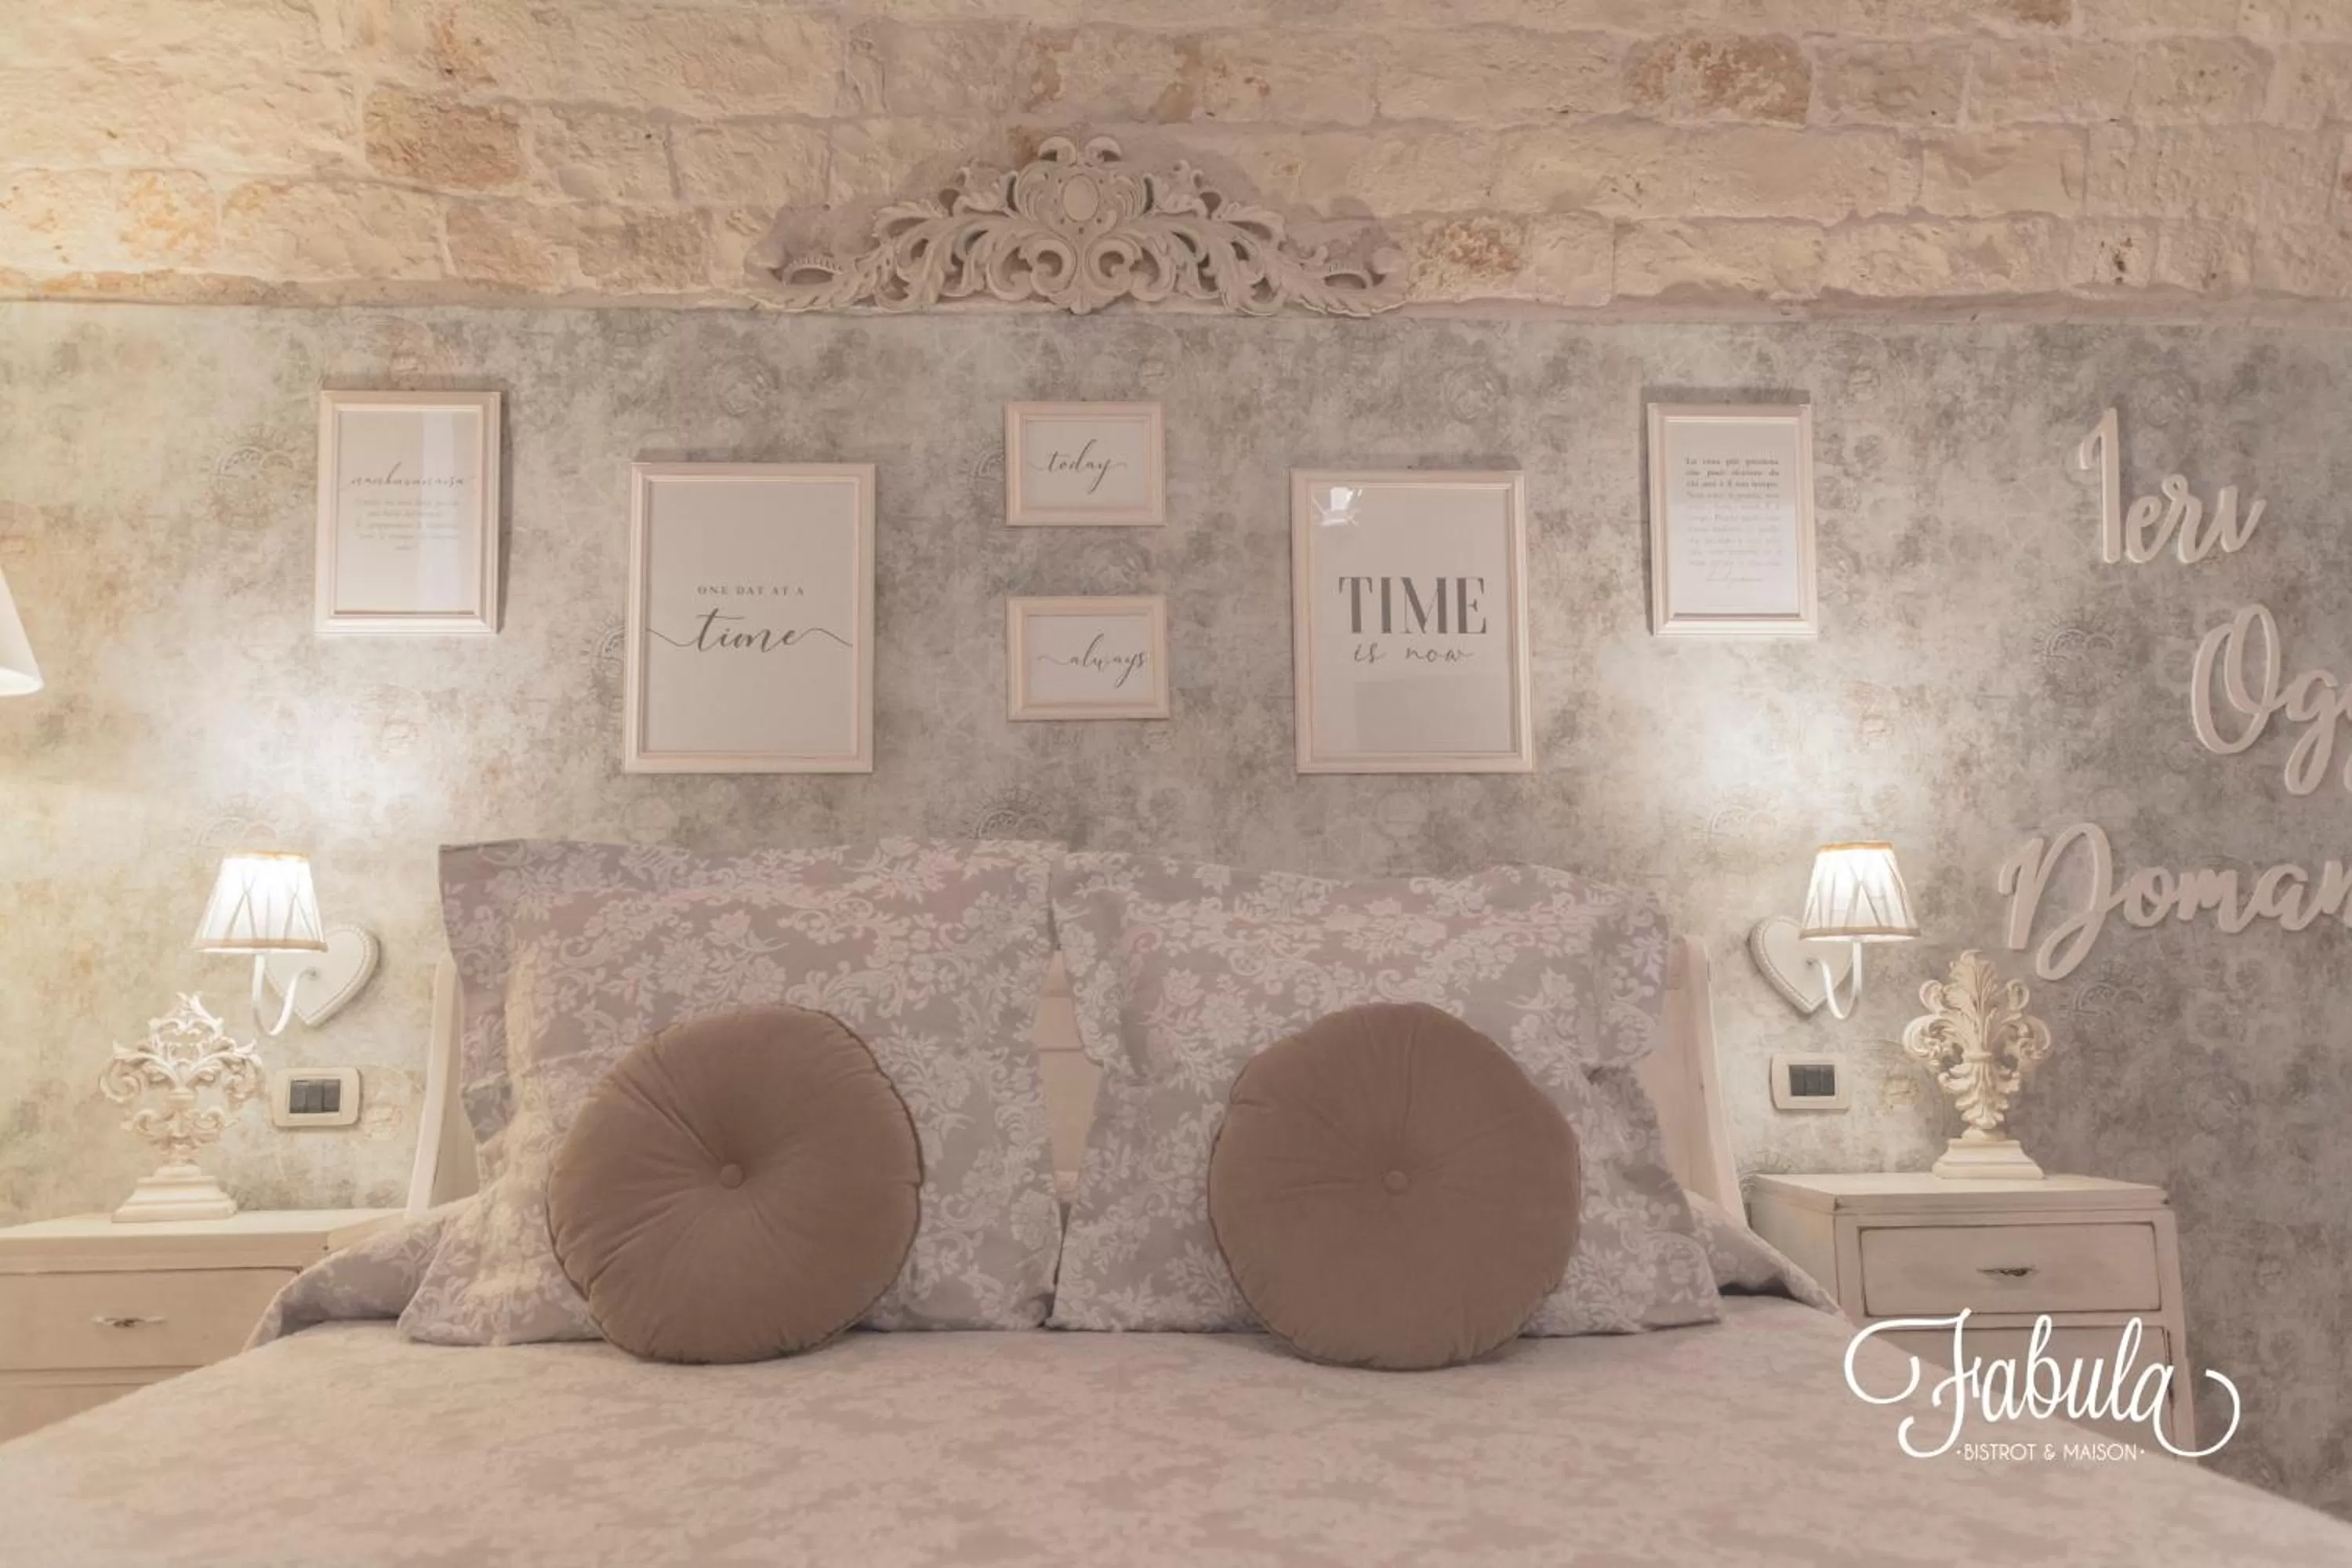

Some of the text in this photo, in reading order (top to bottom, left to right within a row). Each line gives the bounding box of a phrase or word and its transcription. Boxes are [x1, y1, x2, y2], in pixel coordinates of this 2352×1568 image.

[1027, 439, 1127, 495] today
[696, 586, 728, 596] ONE
[1338, 576, 1486, 634] TIME
[1037, 633, 1145, 688] always
[1353, 642, 1475, 664] is now
